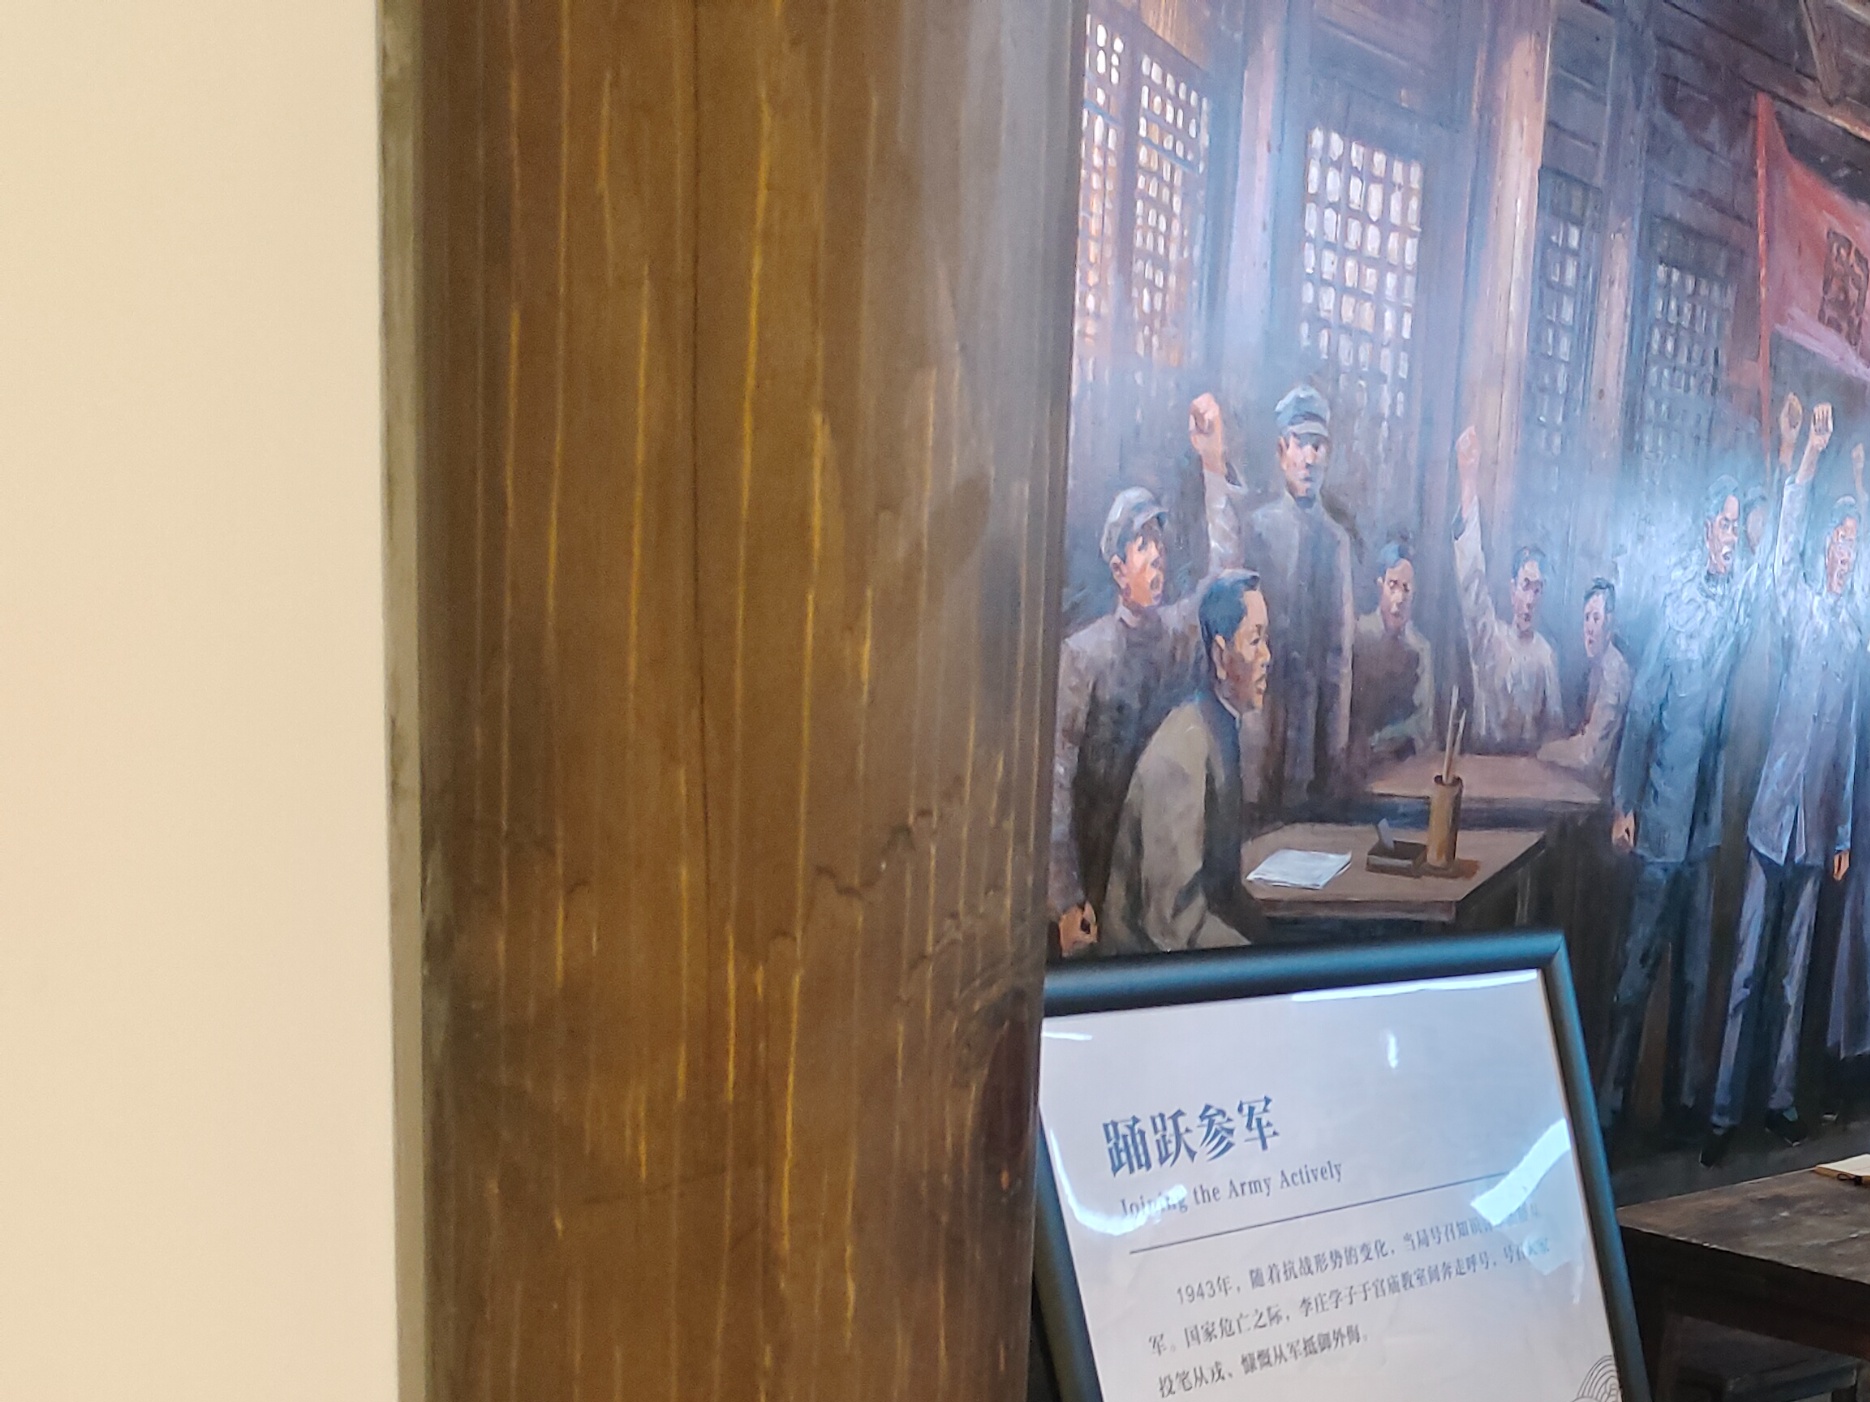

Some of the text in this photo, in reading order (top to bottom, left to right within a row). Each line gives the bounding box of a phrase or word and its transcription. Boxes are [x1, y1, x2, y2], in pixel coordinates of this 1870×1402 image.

[1103, 1095, 1280, 1177] 踊跃参军
[1193, 1184, 1221, 1206] the
[1228, 1177, 1272, 1199] Army
[1280, 1160, 1343, 1190] Actively
